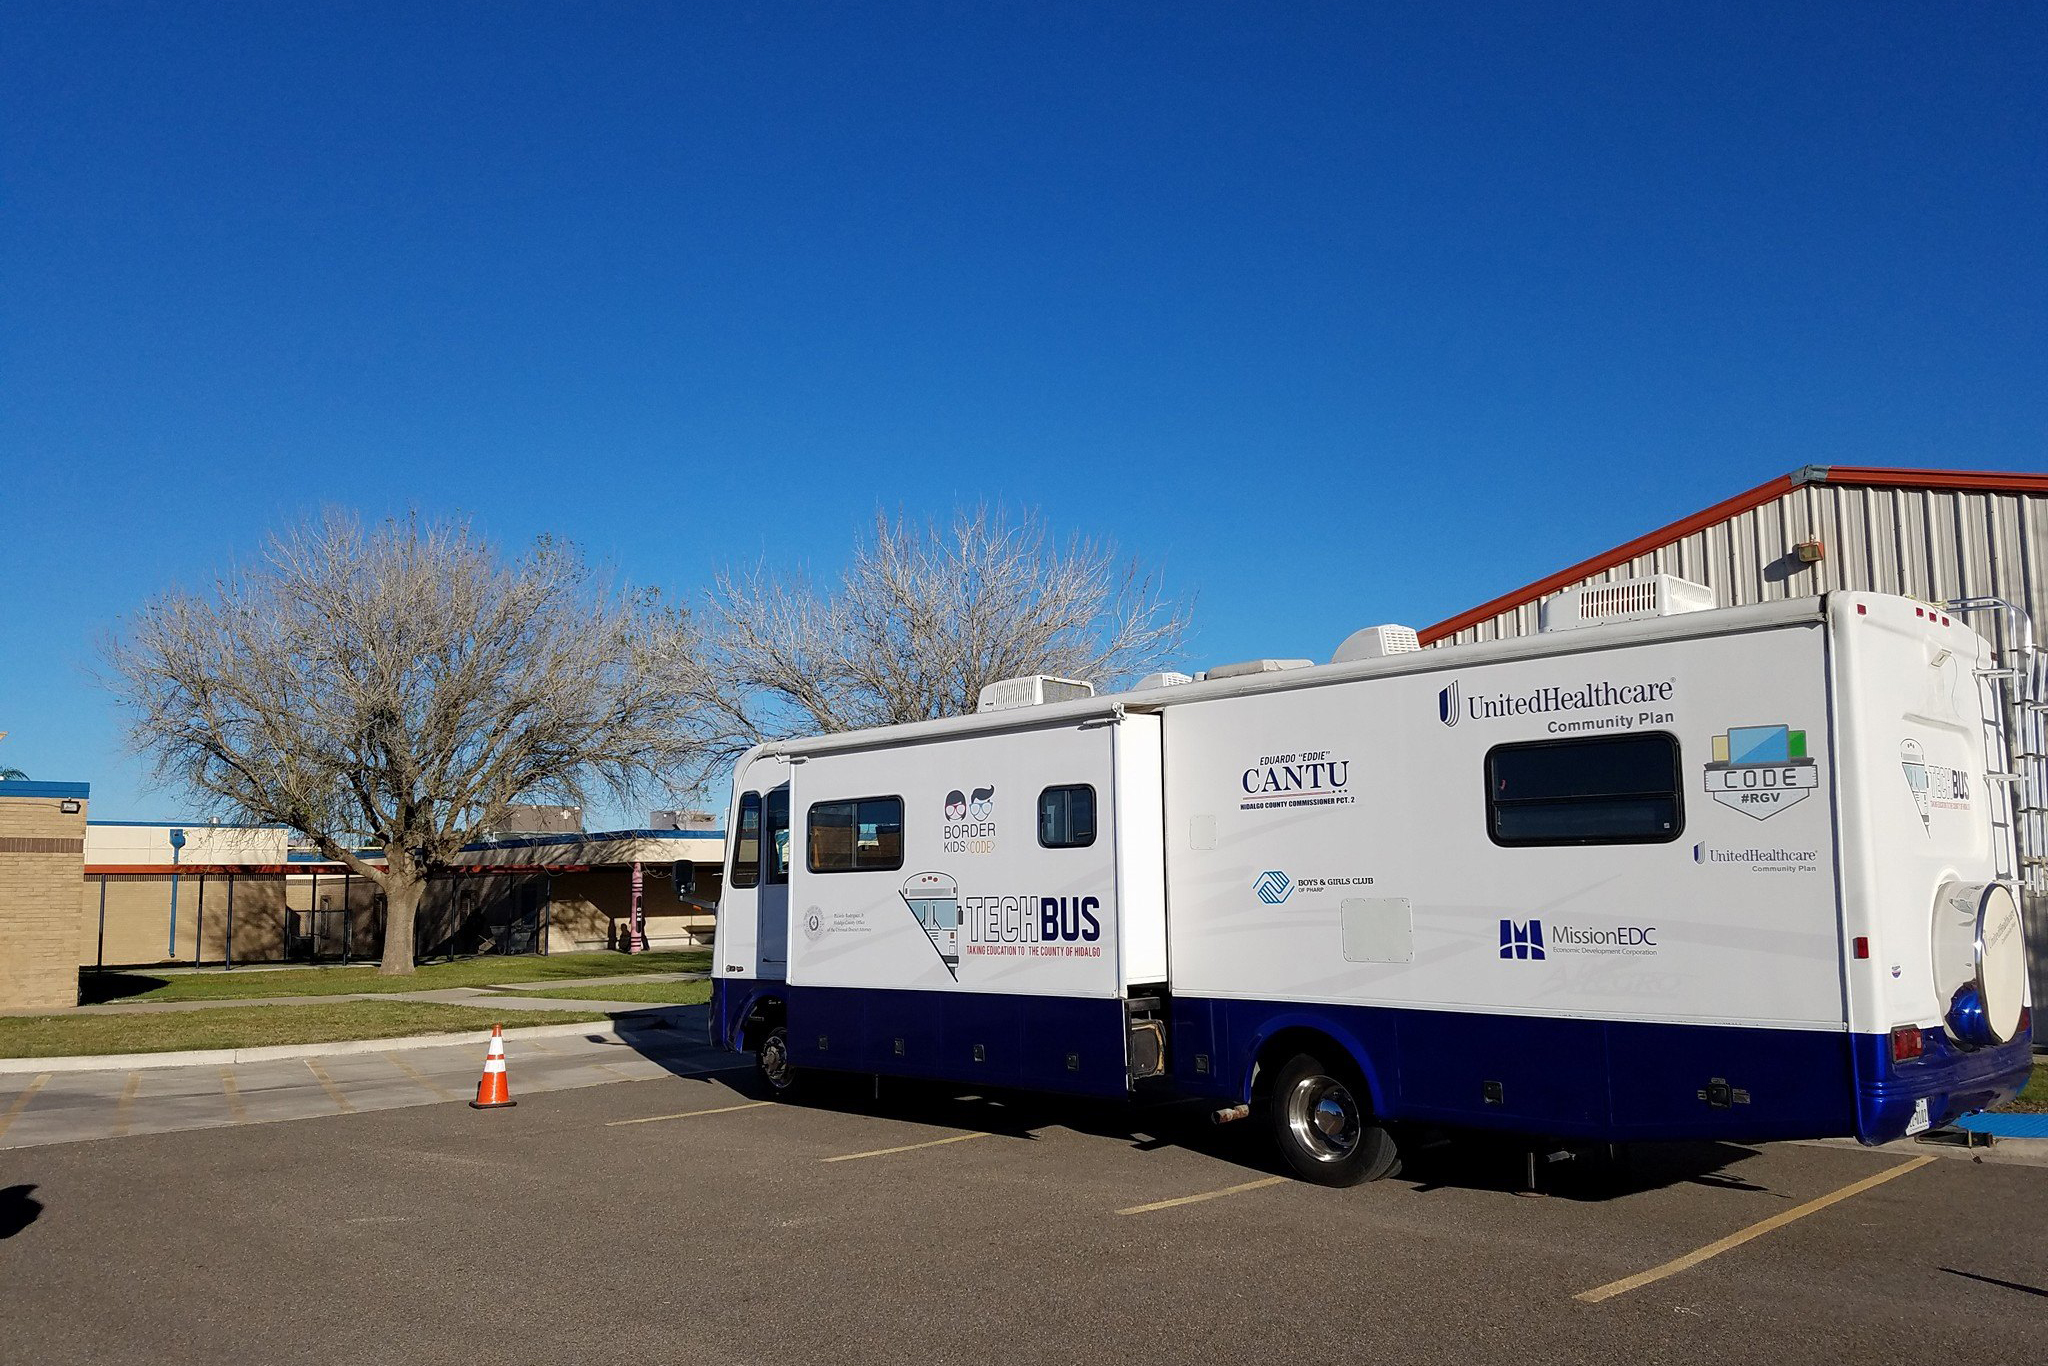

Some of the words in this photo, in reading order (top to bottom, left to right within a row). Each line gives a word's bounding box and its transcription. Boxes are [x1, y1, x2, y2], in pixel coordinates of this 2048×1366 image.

[1547, 714, 1634, 733] Community
[1638, 711, 1675, 725] Plan
[1259, 754, 1296, 766] EDUARDO
[1242, 760, 1350, 794] CANTU
[1723, 768, 1797, 789] CODE
[1240, 802, 1264, 811] HIDALGO
[1264, 801, 1288, 809] COUNTY
[1288, 798, 1335, 808] COMMISSIONER
[1741, 792, 1781, 804] #RGV
[943, 822, 996, 840] BORDER
[1752, 865, 1796, 874] Community
[1798, 864, 1817, 872] Plan
[1298, 879, 1319, 887] BOYS
[1319, 878, 1326, 886] &
[1327, 877, 1351, 886] GIRLS
[1352, 877, 1374, 885] CLUB
[1552, 926, 1657, 946] MissionEDC
[966, 945, 986, 956] TAKING
[986, 945, 1017, 956] EDUCATION
[1018, 946, 1025, 956] TO
[1028, 946, 1040, 957] THE
[1040, 946, 1065, 957] COUNTY
[1065, 946, 1073, 957] OF
[1074, 946, 1101, 958] HIDALGO
[1581, 947, 1621, 956] Development
[1621, 948, 1658, 956] Corporation
